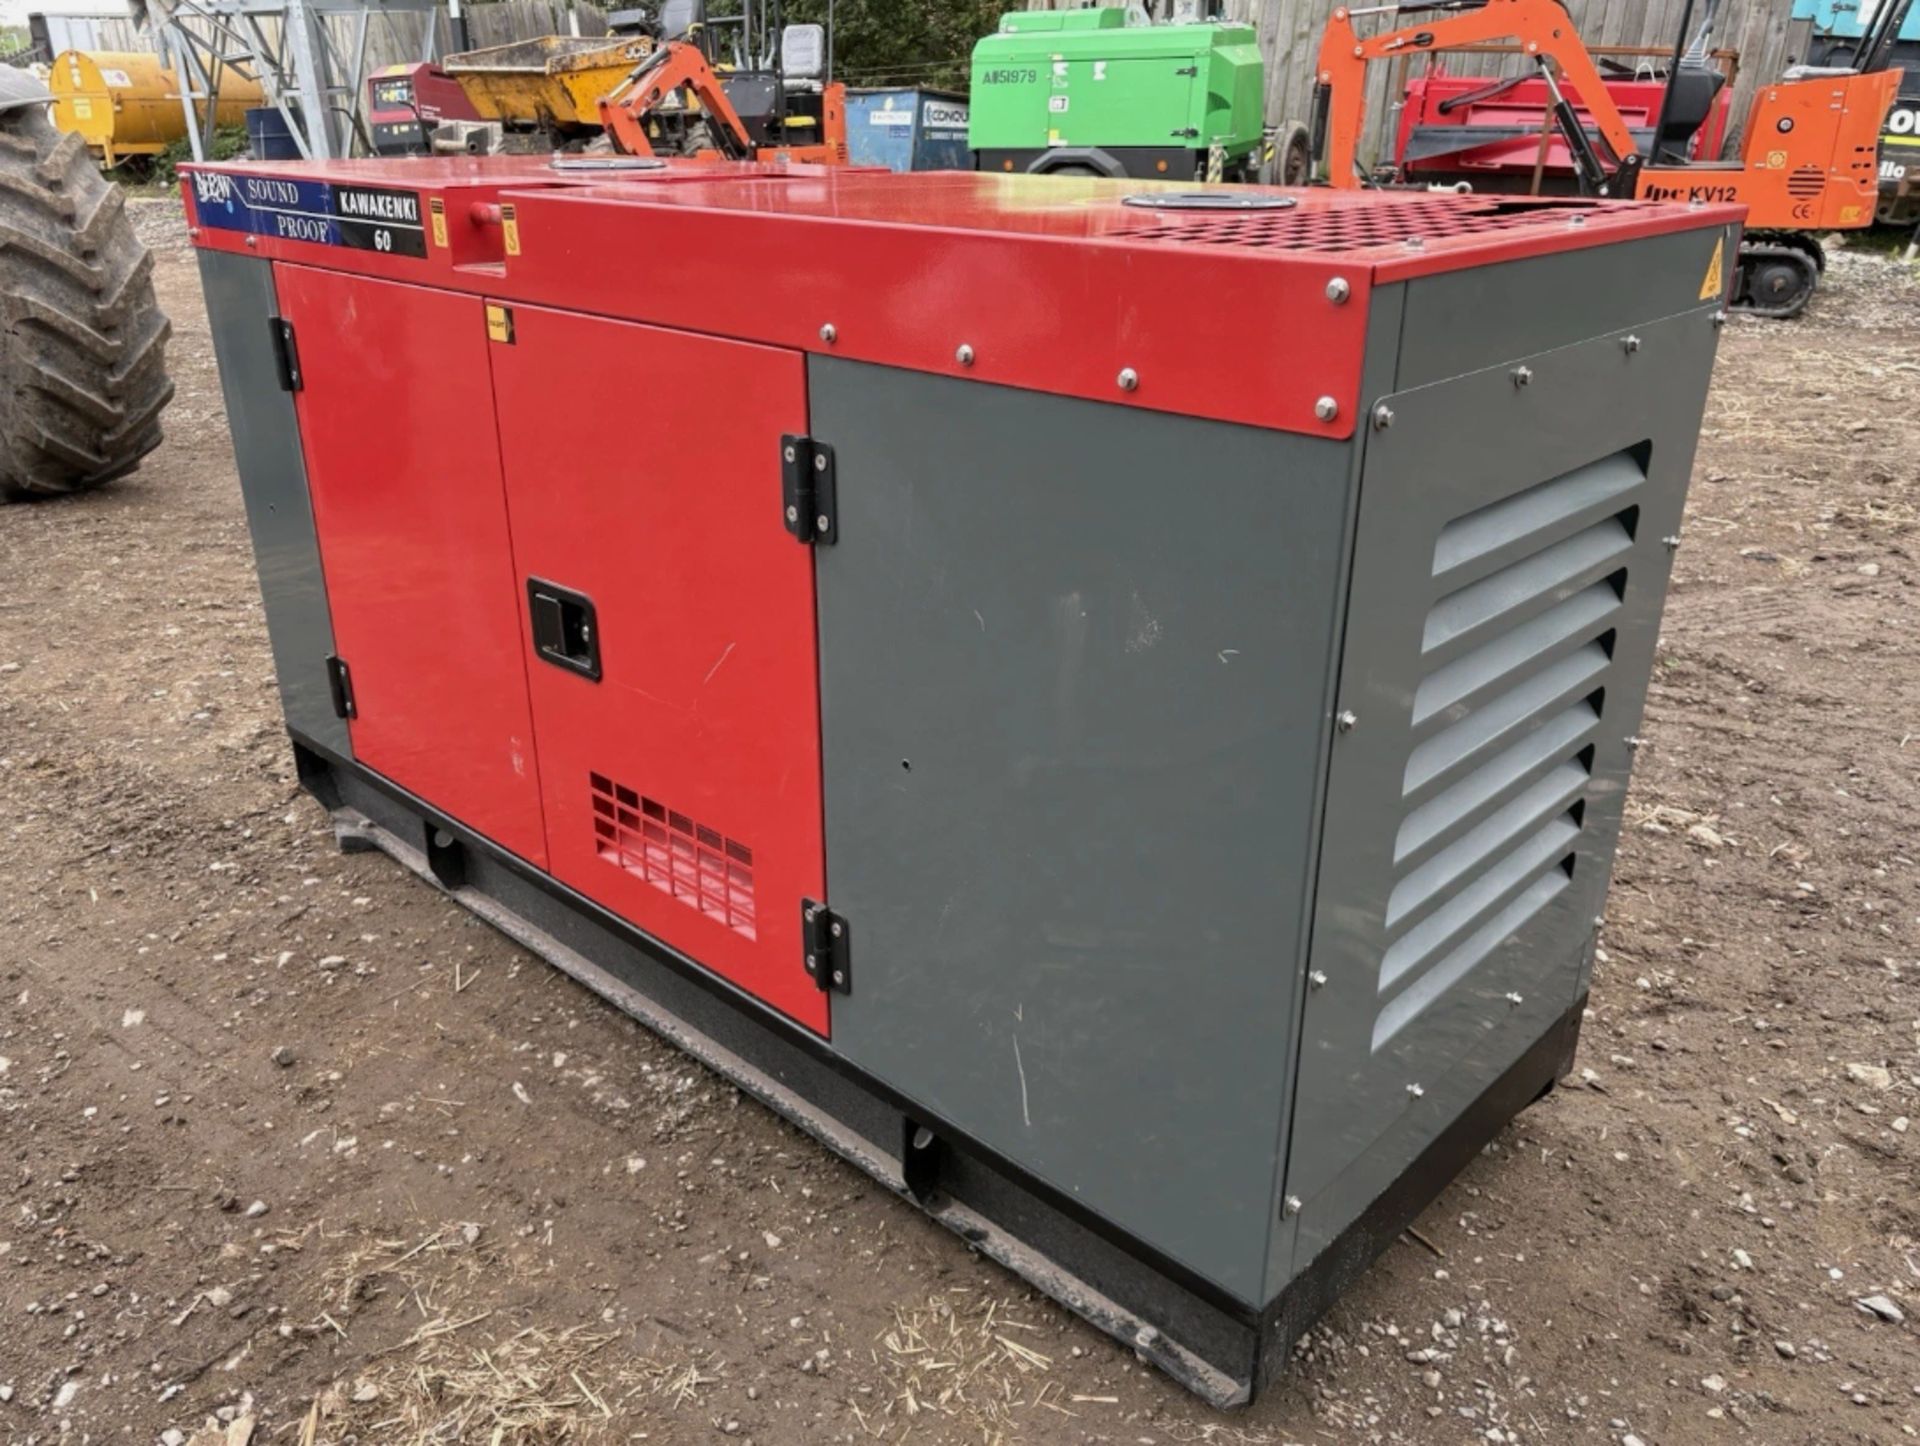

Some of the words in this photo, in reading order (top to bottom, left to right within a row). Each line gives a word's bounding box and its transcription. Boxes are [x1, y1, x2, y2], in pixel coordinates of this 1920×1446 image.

[247, 178, 299, 205] SOUND
[1688, 186, 1736, 203] KV12
[339, 191, 418, 221] KAWAKENKI
[277, 214, 329, 243] PROOF
[374, 229, 391, 251] 60
